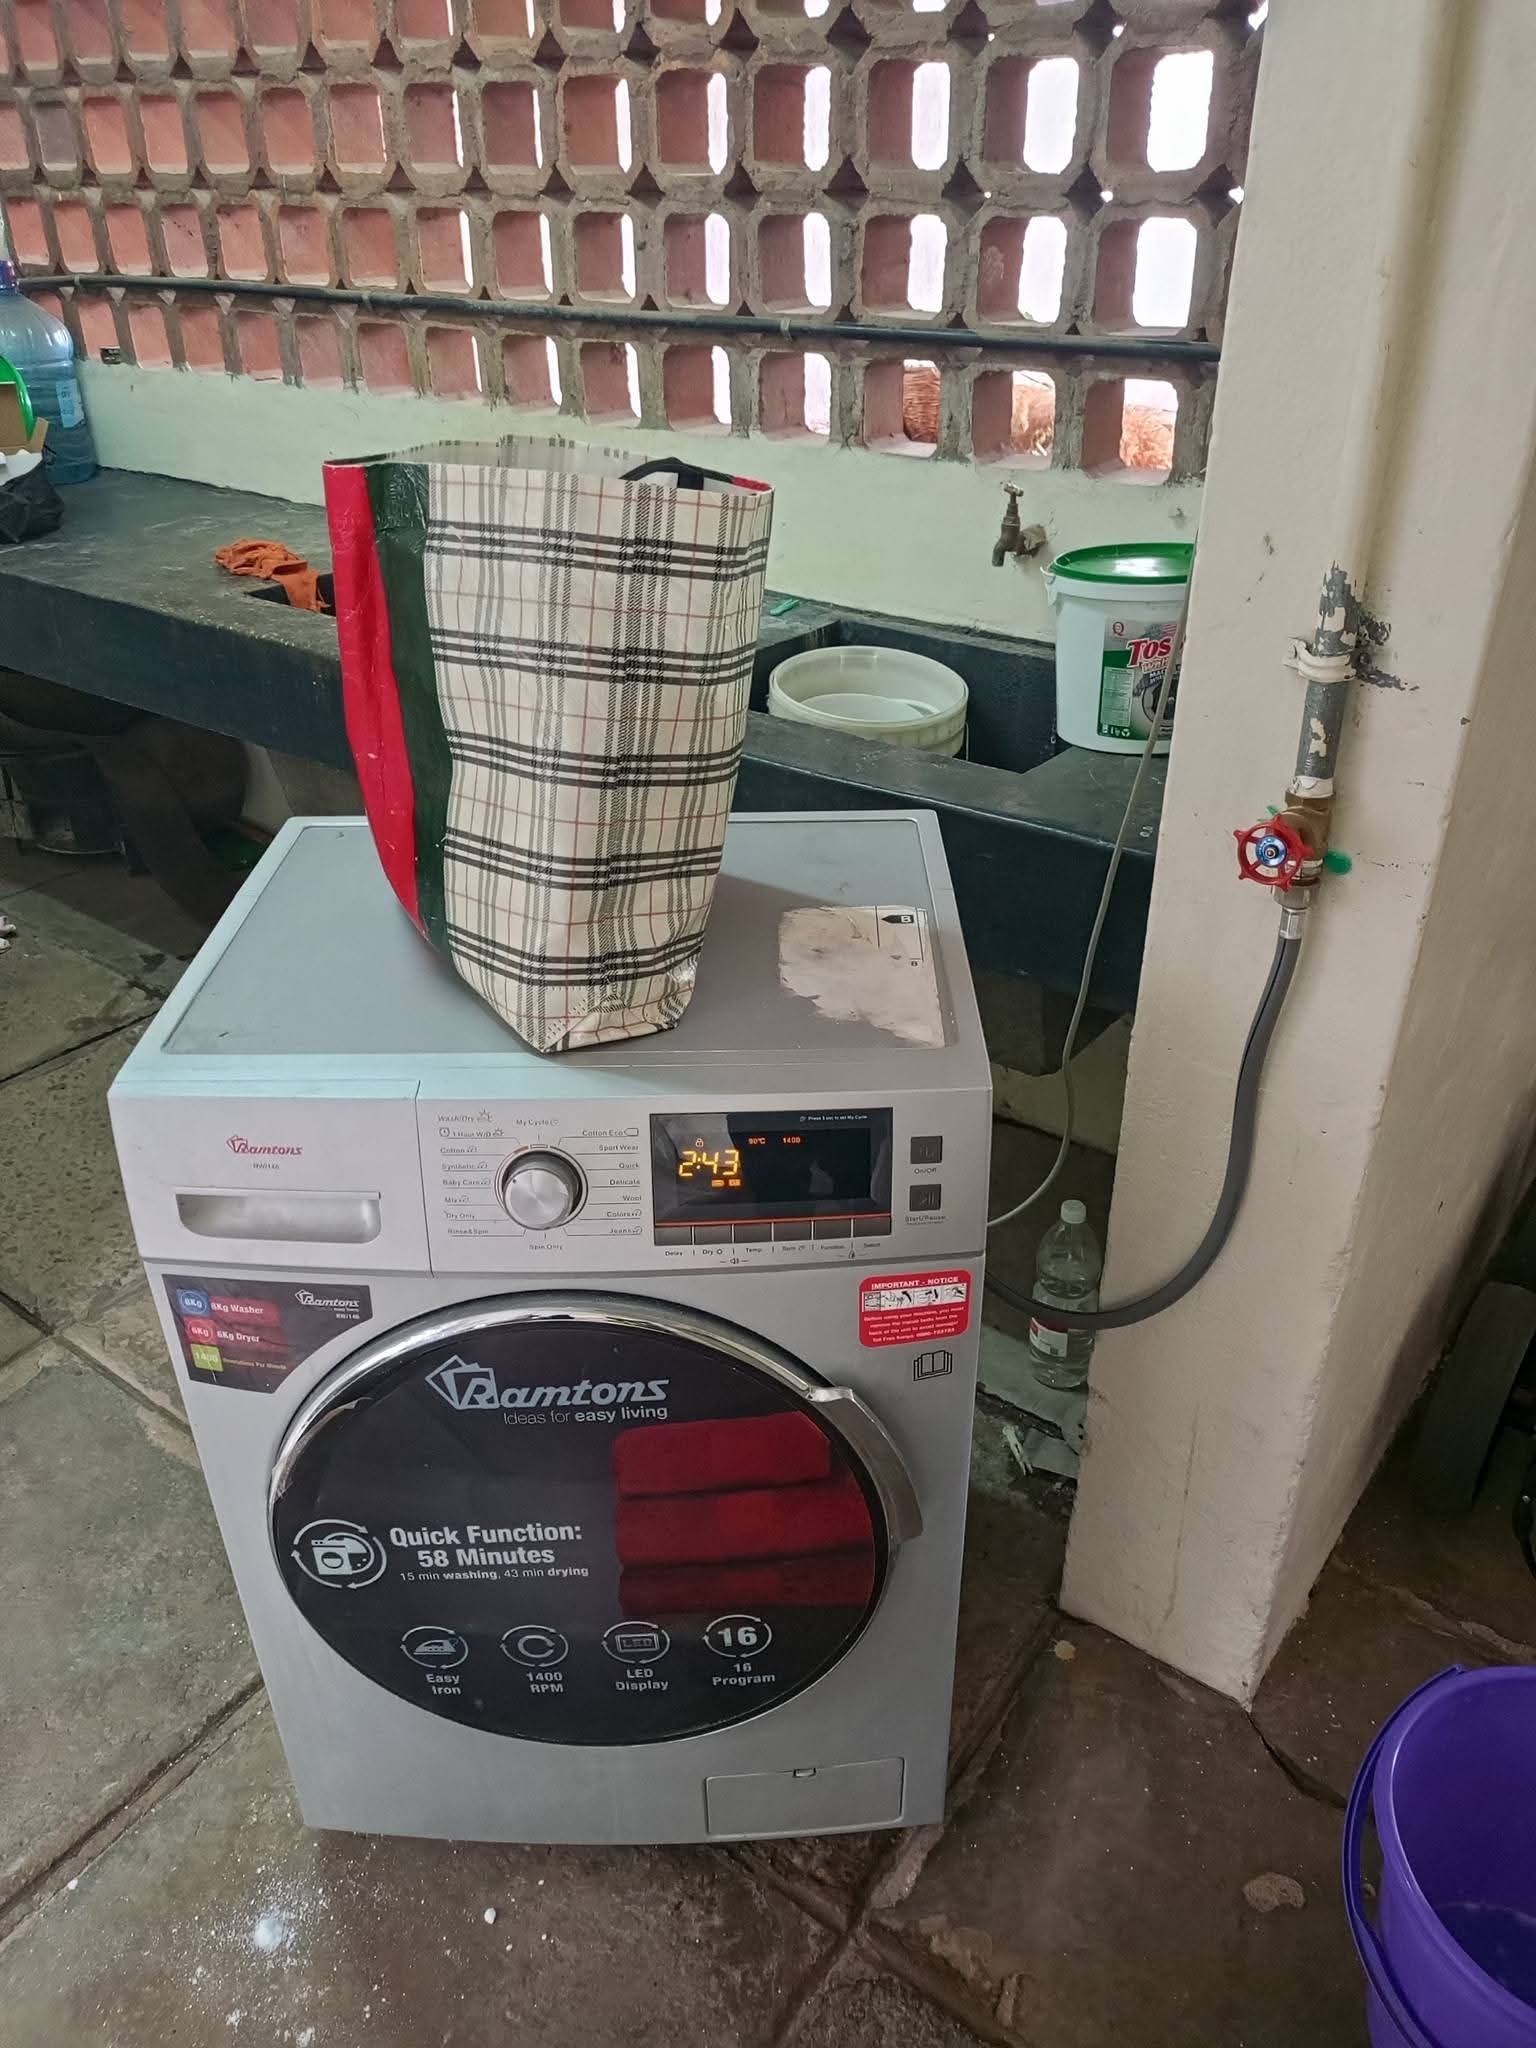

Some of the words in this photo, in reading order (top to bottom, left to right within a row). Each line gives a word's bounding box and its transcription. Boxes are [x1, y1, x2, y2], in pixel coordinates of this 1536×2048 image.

[236, 1138, 303, 1156] Ramtons
[678, 1148, 740, 1177] 2:43
[871, 1279, 920, 1291] IMPORTANT
[927, 1276, 959, 1286] NOTICE
[303, 1292, 360, 1307] Ramtons
[230, 1303, 264, 1314] Washer
[236, 1332, 260, 1343] Dryer
[456, 1373, 669, 1409] Ramtons
[503, 1411, 546, 1425] Ideas
[550, 1410, 570, 1424] for
[574, 1408, 616, 1424] easy
[621, 1406, 668, 1421] living
[389, 1527, 461, 1548] Quick
[466, 1523, 583, 1544] Function:
[417, 1550, 450, 1567] 58
[456, 1547, 556, 1566] Minutes
[400, 1572, 415, 1582] 15
[418, 1570, 441, 1581] min
[442, 1569, 501, 1582] washing,
[504, 1568, 519, 1578] 43
[523, 1567, 543, 1578] min
[547, 1566, 589, 1579] drying
[718, 1626, 757, 1647] 16
[626, 1668, 654, 1679] LED
[733, 1662, 752, 1673] 16
[425, 1674, 460, 1687] Easy
[526, 1672, 563, 1683] 1400
[712, 1673, 776, 1687] Program
[432, 1684, 462, 1696] Iron
[530, 1682, 564, 1694] RPM
[615, 1679, 669, 1693] Display
